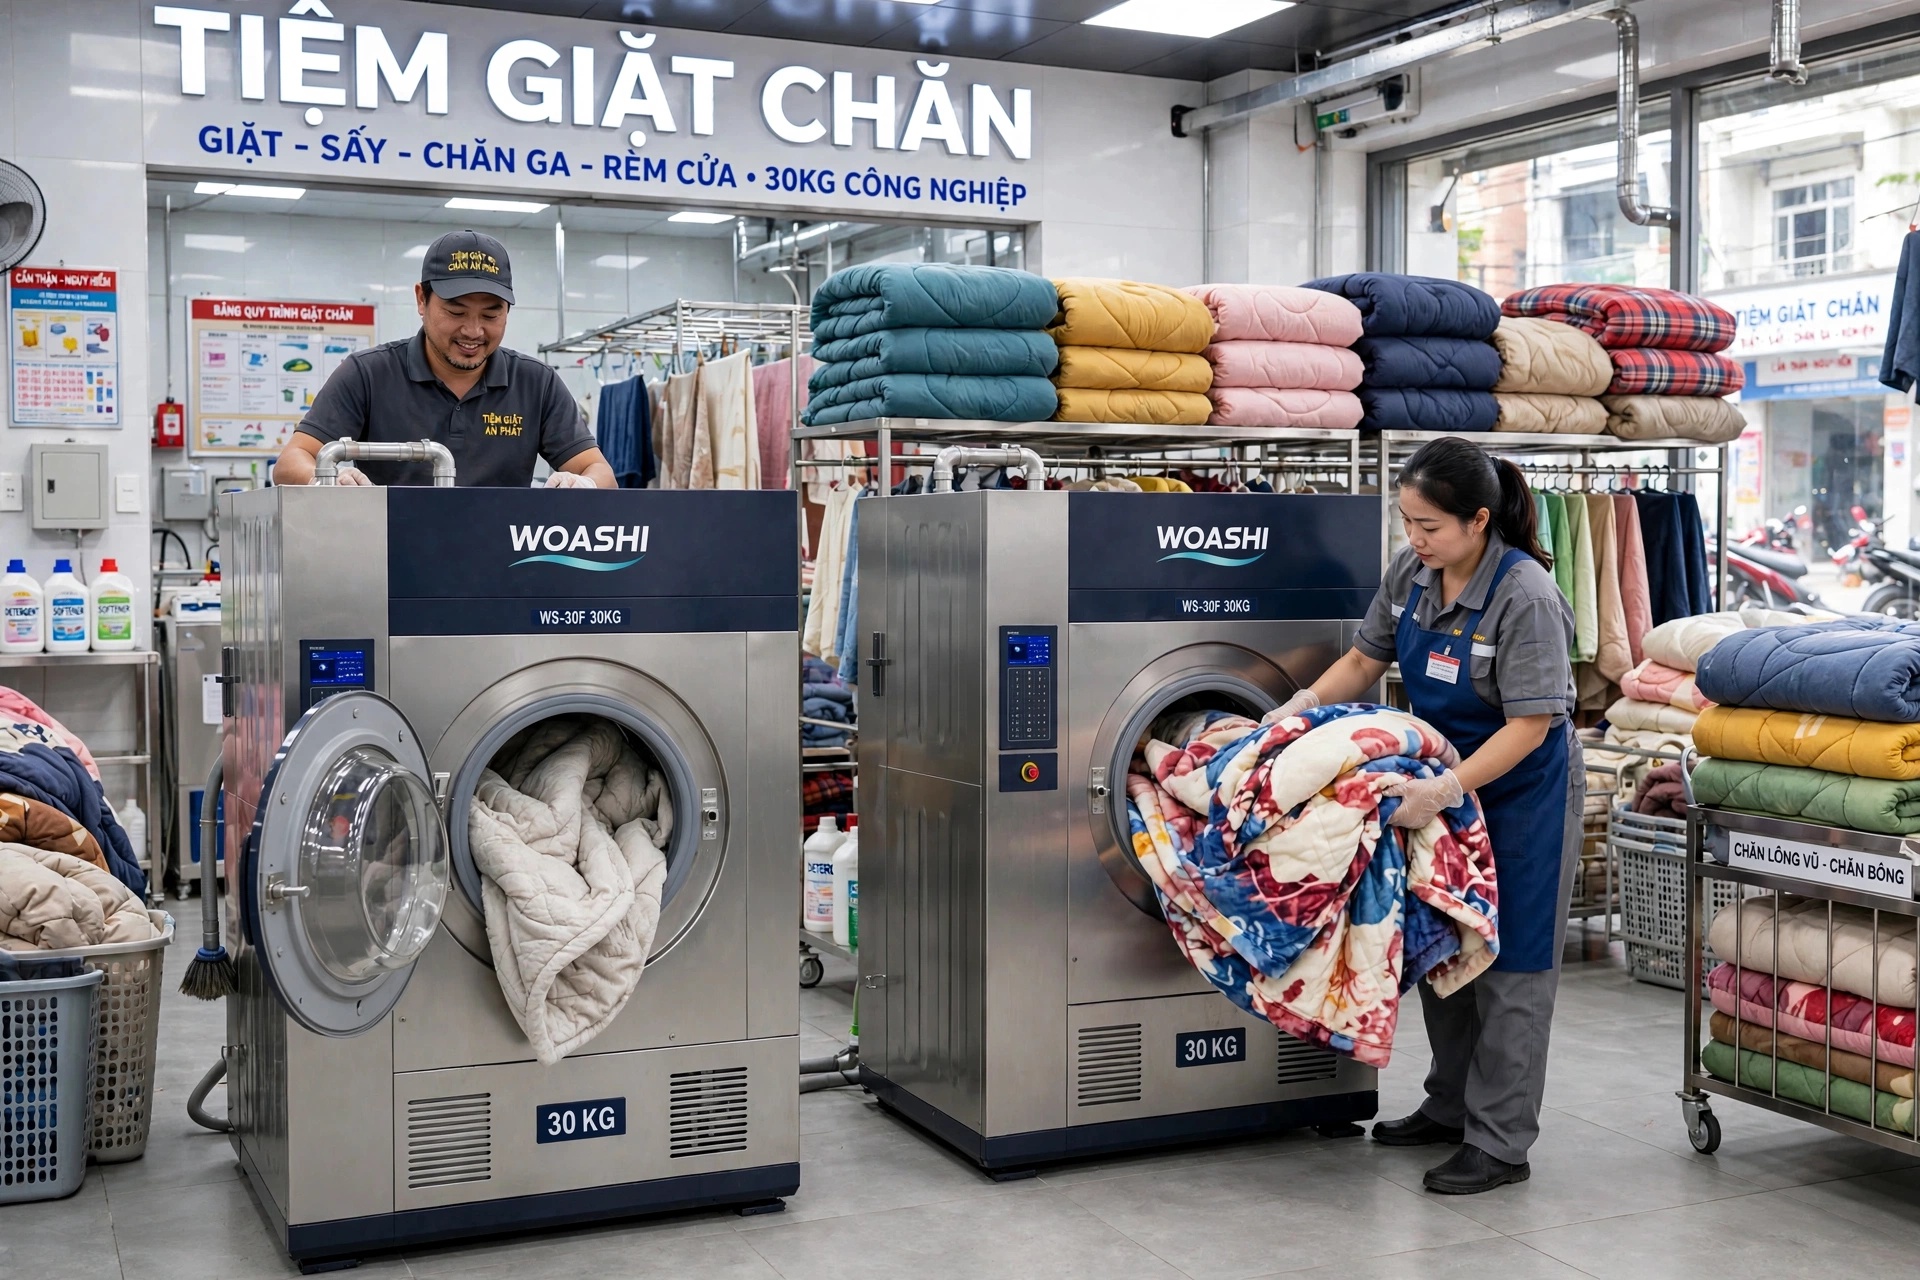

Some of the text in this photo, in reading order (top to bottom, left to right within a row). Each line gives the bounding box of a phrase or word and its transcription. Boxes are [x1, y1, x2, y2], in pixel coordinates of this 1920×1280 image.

[154, 0, 1032, 160] TIỆM GIẶT CHĂN
[198, 121, 283, 164] GIẶT
[321, 125, 388, 165] SẤY
[422, 138, 516, 173] CHĂN
[526, 148, 571, 177] GA
[603, 149, 668, 184] RÈM
[676, 153, 738, 188] CỬA
[764, 165, 837, 194] 30KG
[844, 166, 922, 201] CÔNG
[930, 176, 1028, 212] NGHIỆP
[213, 301, 242, 316] BẢNG
[244, 305, 265, 319] QUY
[300, 305, 323, 323] GIẶT
[324, 307, 354, 321] CHĂN
[1826, 291, 1880, 319] CHĂN
[509, 524, 650, 553] WOASHI
[1156, 525, 1270, 550] WOASHI
[97, 604, 131, 615] SOFTENER
[539, 609, 622, 625] WS-30F 30KG
[1182, 599, 1251, 613] WS-30F 30KG
[1734, 841, 1765, 861] CHĂN
[1767, 845, 1801, 867] LÔNG
[1802, 851, 1819, 870] VŨ
[1829, 857, 1864, 879] CHĂN
[1867, 862, 1905, 885] BÔNG
[1185, 1035, 1237, 1061] 30 KG
[547, 1106, 615, 1136] 30 KG
